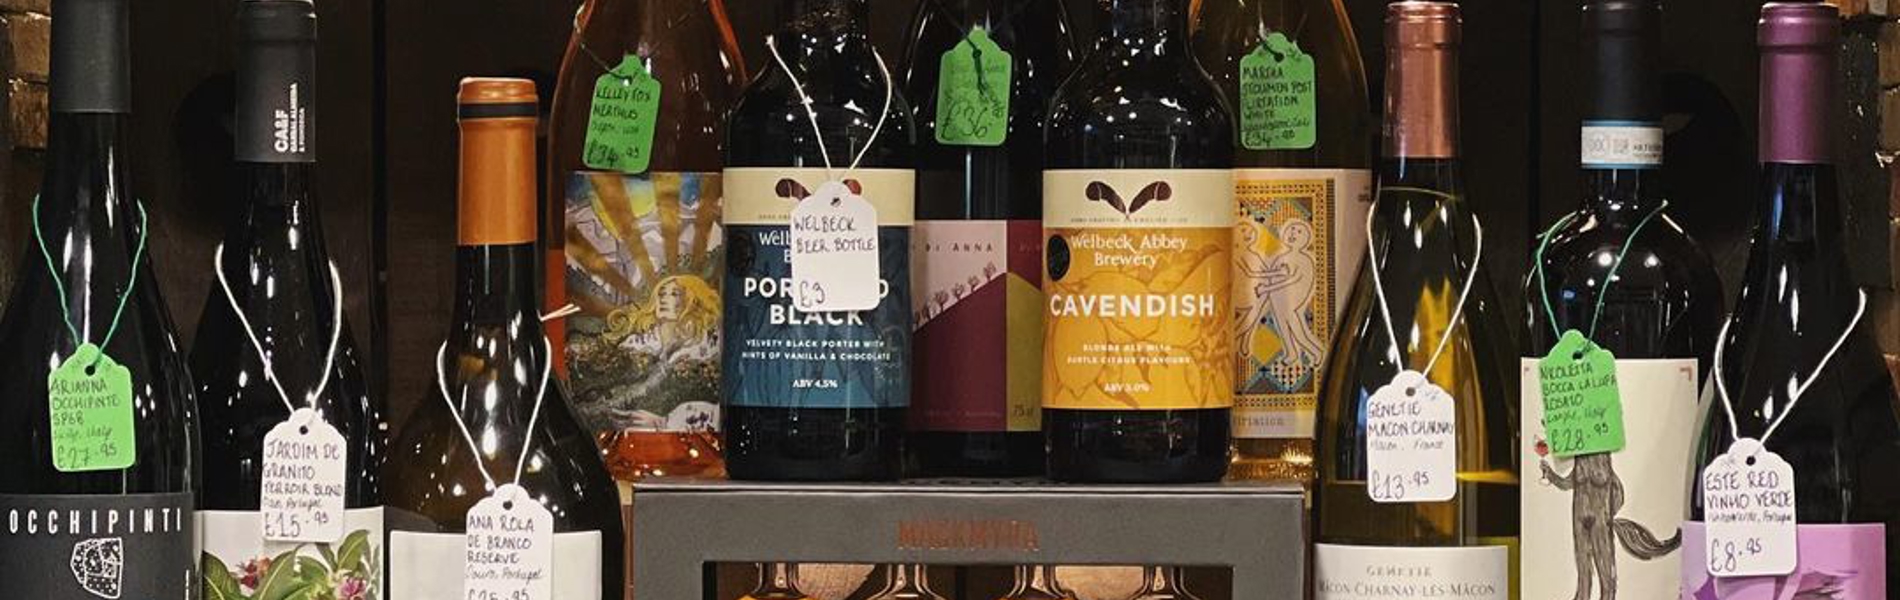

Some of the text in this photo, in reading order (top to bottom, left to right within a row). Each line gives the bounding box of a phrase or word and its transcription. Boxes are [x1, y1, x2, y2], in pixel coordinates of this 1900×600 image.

[274, 109, 289, 153] CA&F
[794, 215, 856, 233] WELBECK
[796, 238, 876, 254] BEER BOTTLE
[1070, 234, 1188, 254] Welbeck Abbey
[1094, 252, 1157, 269] Brewery
[1050, 294, 1215, 318] CAVENDISH
[786, 339, 817, 348] BLACK
[821, 339, 860, 348] PORTER
[768, 352, 781, 360] OF
[784, 352, 826, 361] VANILLA
[840, 353, 891, 361] CHOCOLATE
[50, 378, 108, 395] ARIANNA
[792, 380, 814, 388] ABV
[1104, 383, 1123, 392] ABV
[1368, 421, 1409, 437] MACON
[265, 438, 318, 460] JARDIM
[262, 462, 315, 481] GRANITO
[1706, 471, 1779, 491] ESTE RED
[1707, 491, 1793, 509] VINHO VERDE
[9, 507, 182, 534] OCCHIPINTI
[469, 515, 535, 533] ANA ROLA
[467, 535, 533, 550] DE BRANCO
